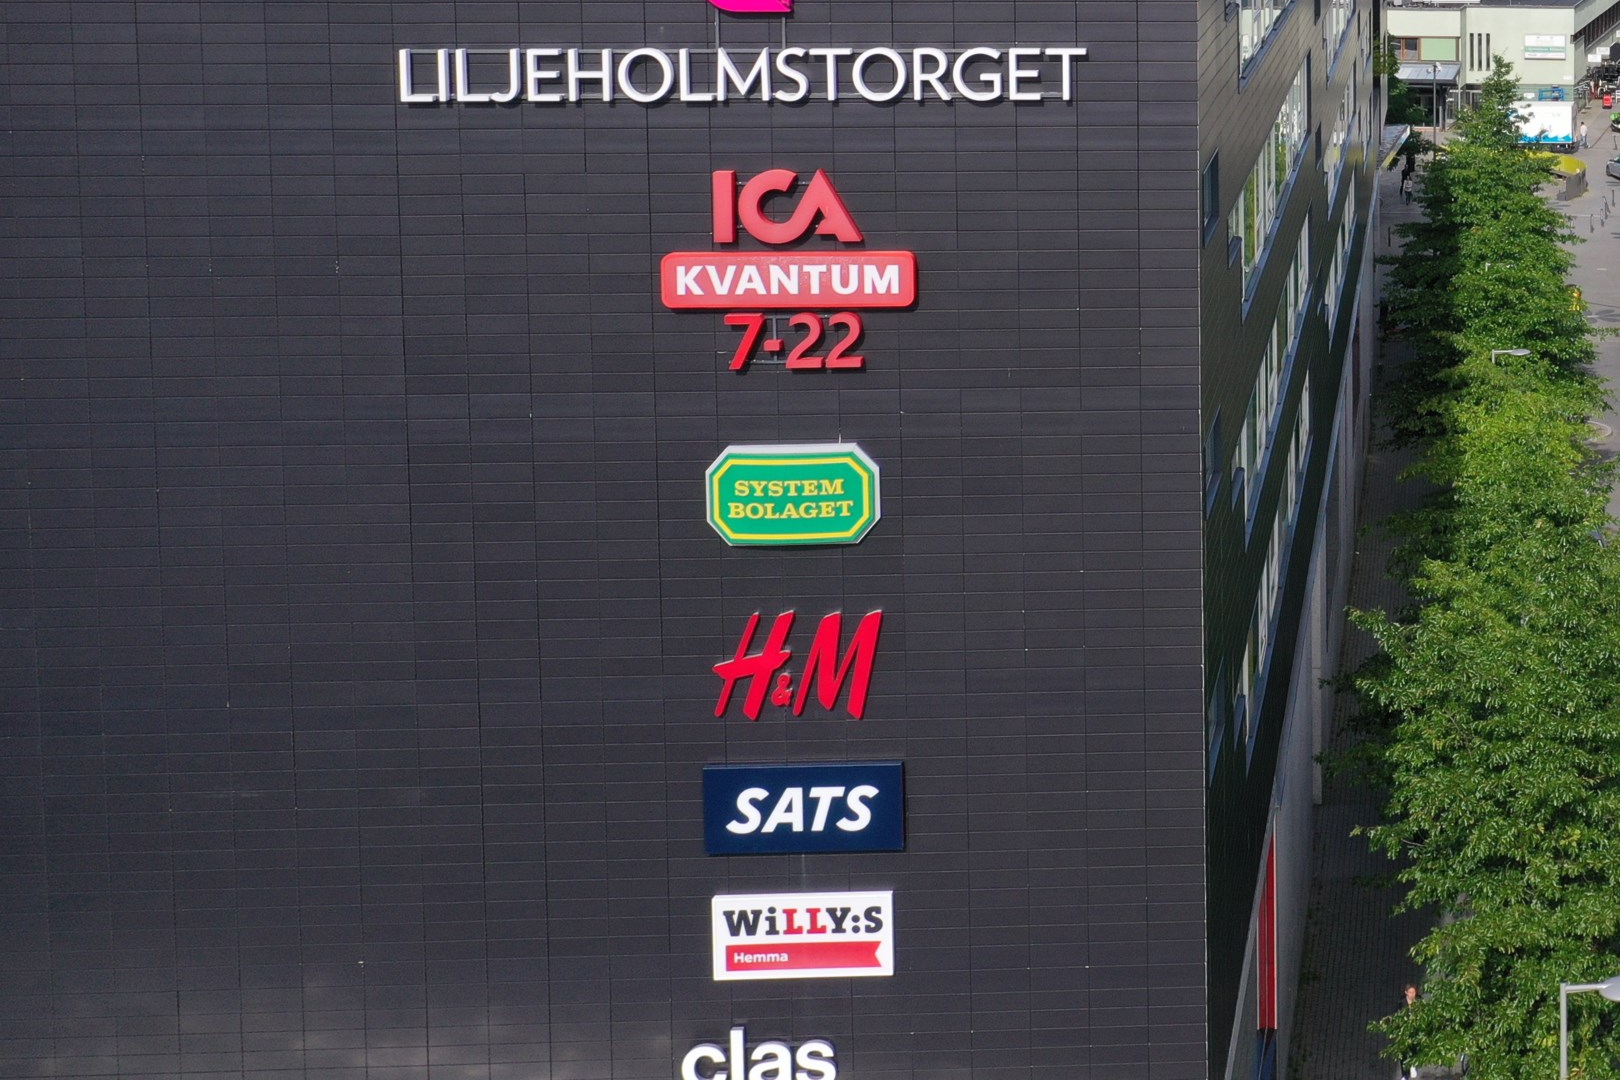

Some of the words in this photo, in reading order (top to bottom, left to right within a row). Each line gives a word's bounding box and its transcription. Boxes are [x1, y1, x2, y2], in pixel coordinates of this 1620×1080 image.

[399, 47, 1087, 103] LILJEHOLMSTORGET
[712, 168, 863, 244] ICA
[676, 264, 900, 296] KVANTUM
[724, 312, 865, 370] 7-22
[728, 500, 853, 518] BOLAGET
[735, 479, 844, 496] SYSTEM
[712, 610, 882, 720] H&M
[726, 785, 879, 834] SATS
[734, 951, 788, 963] Hemma
[681, 1026, 837, 1080] clas
